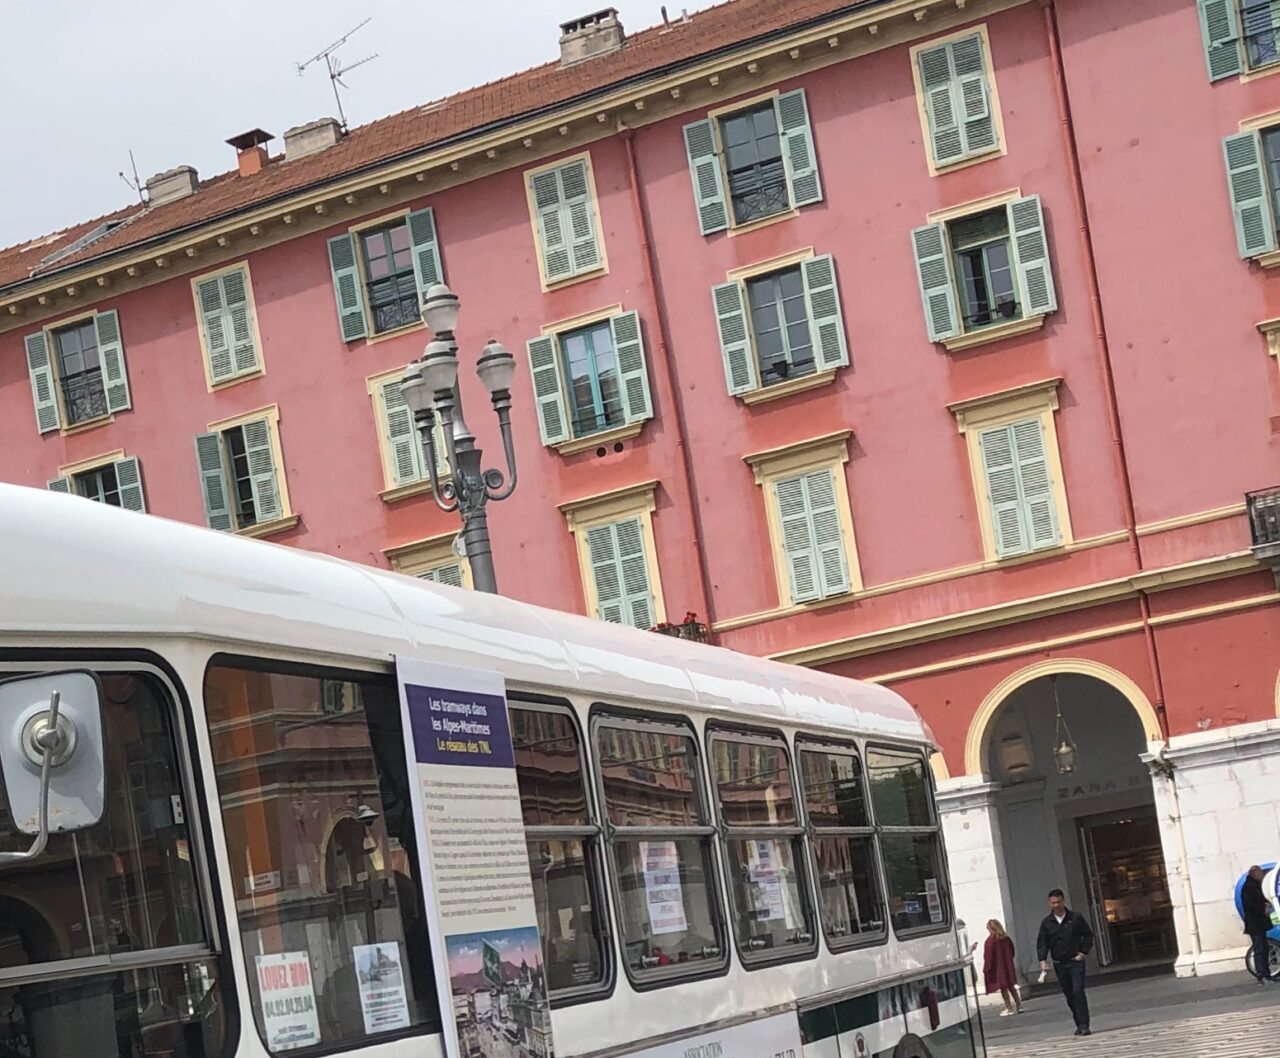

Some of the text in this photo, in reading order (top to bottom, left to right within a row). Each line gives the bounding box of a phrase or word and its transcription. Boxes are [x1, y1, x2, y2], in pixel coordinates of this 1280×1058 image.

[428, 696, 487, 717] Les tramways dans
[1057, 780, 1116, 799] ZARA
[259, 964, 289, 992] LOUEZ
